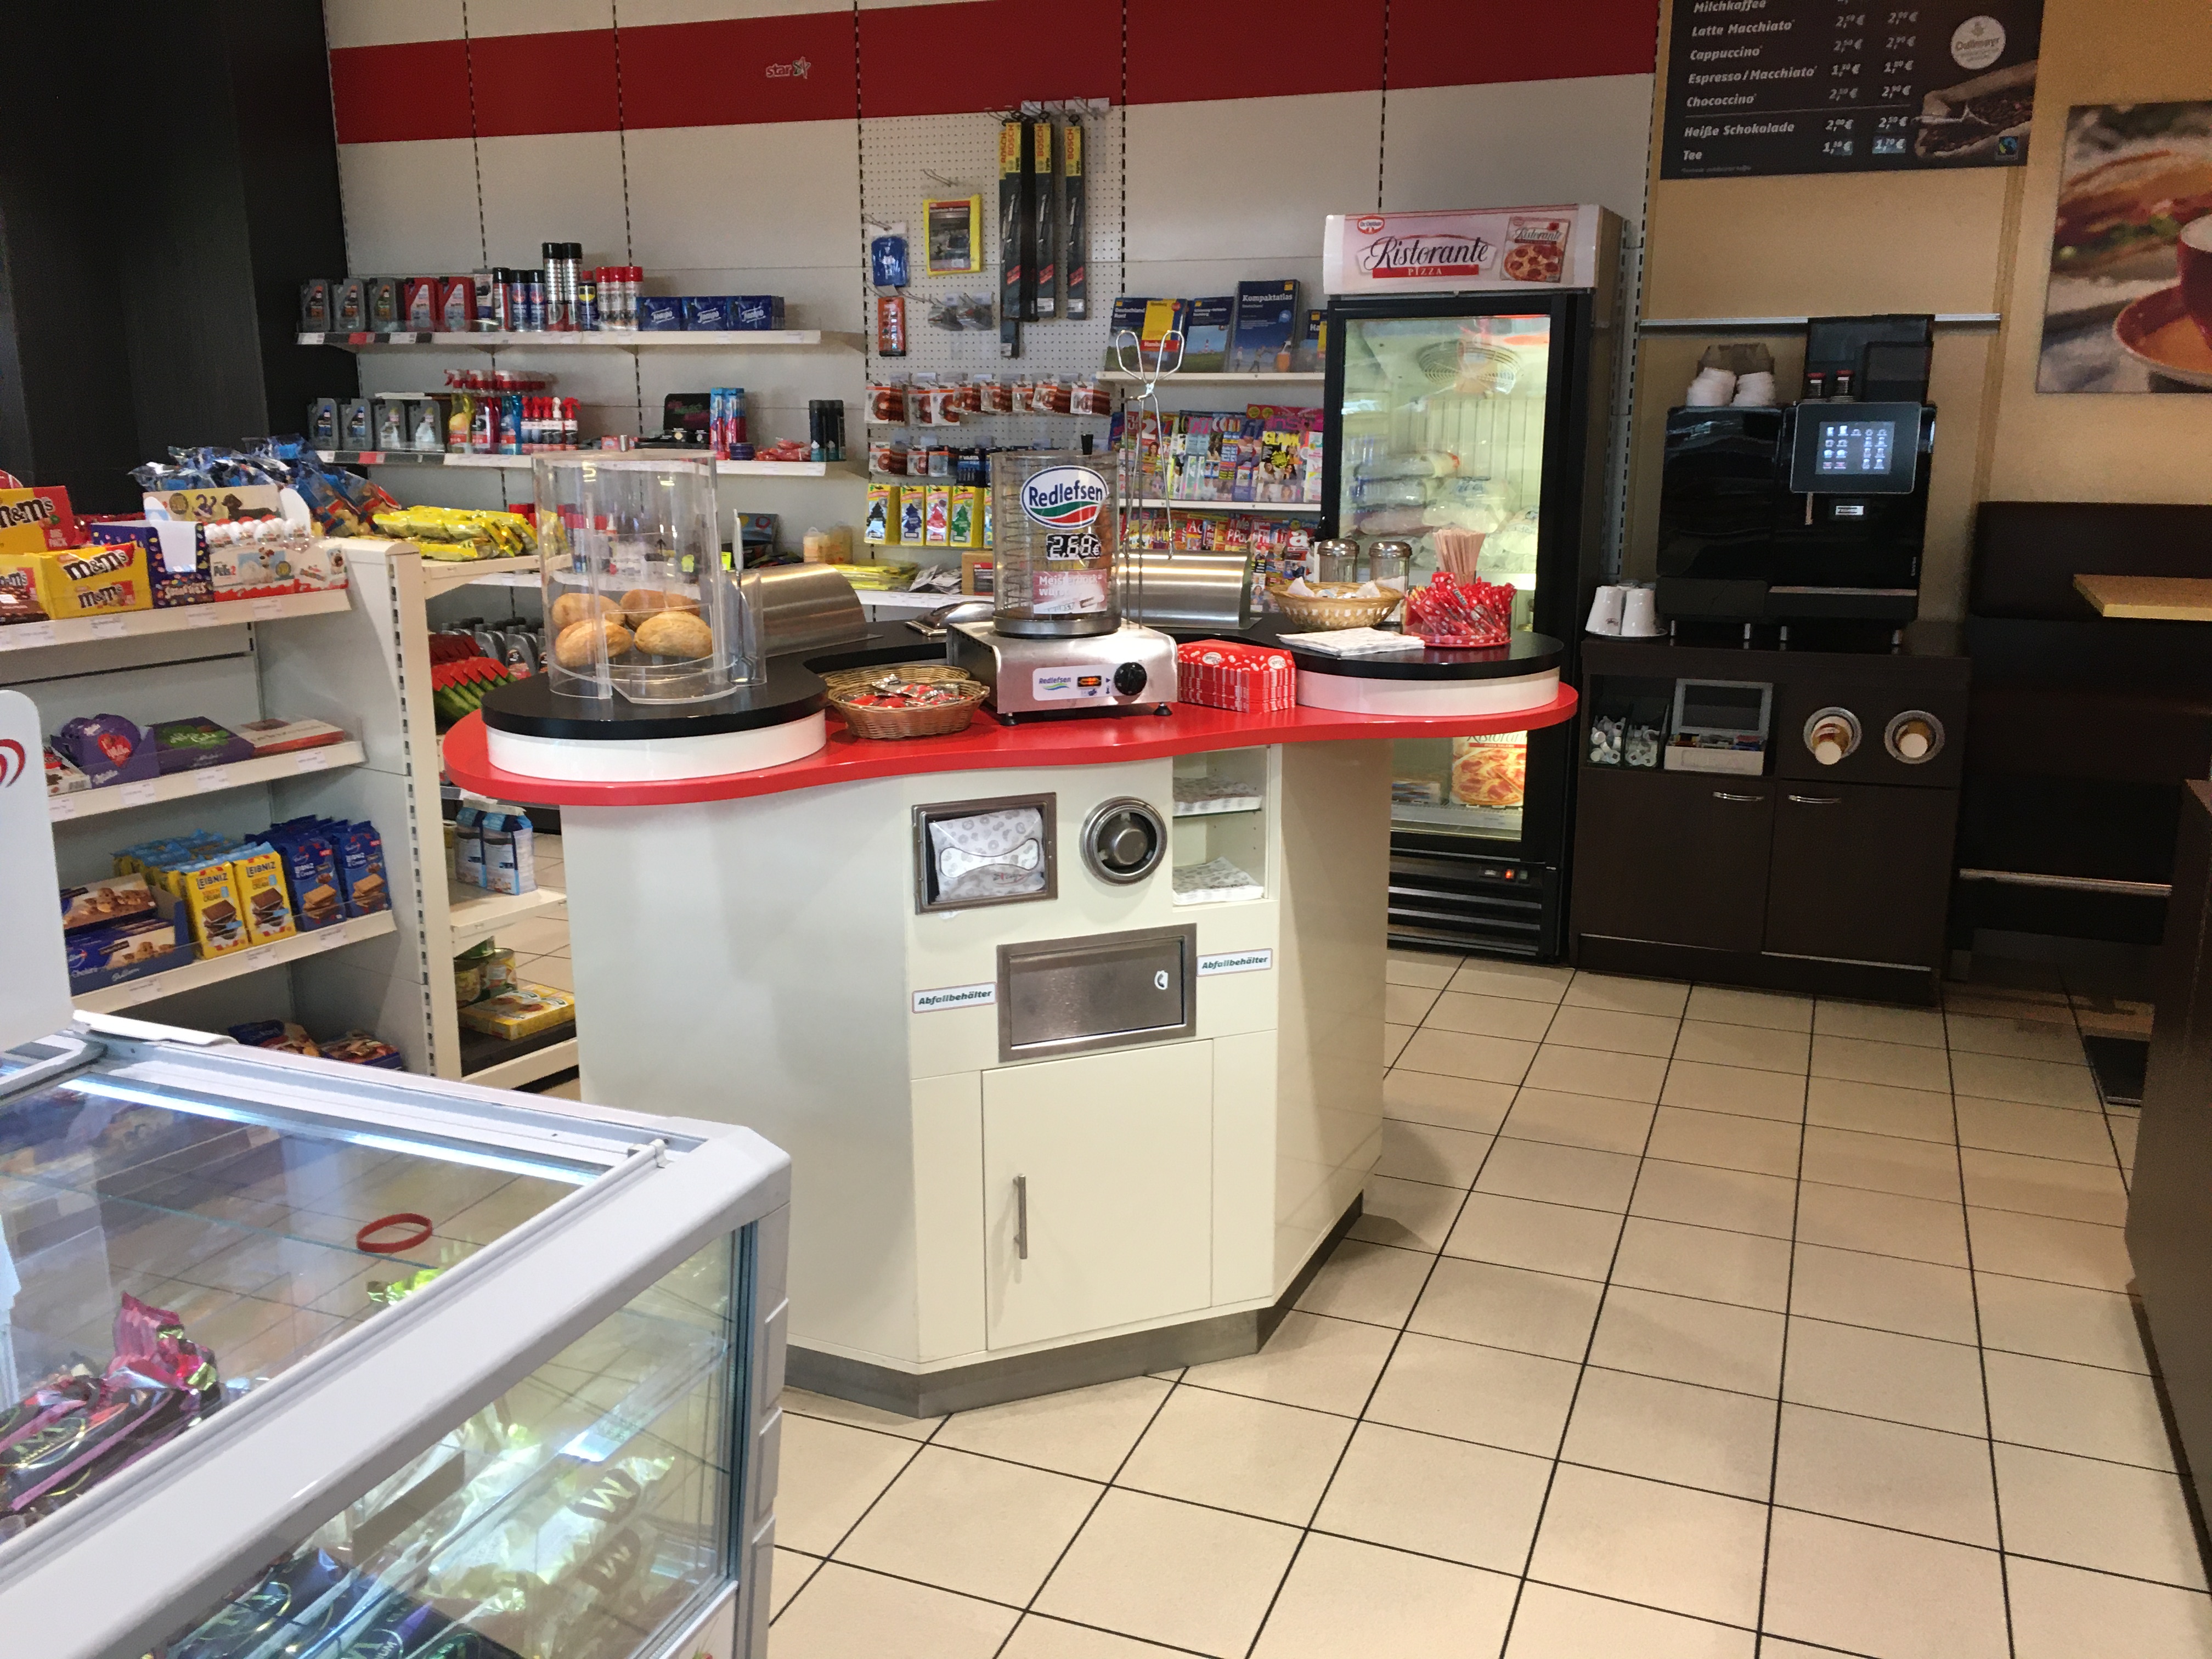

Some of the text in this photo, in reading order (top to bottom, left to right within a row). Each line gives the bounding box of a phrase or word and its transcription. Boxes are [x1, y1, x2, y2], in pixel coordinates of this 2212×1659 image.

[1691, 26, 1724, 37] Latte
[766, 63, 792, 77] star
[1684, 125, 1720, 138] Heiße
[1684, 150, 1702, 161] Tee
[1364, 236, 1489, 271] Ristorante
[1408, 267, 1442, 275] PIZZA
[1242, 293, 1293, 303] Kompaktatlas
[1029, 479, 1103, 507] Redlefsen
[245, 862, 276, 878] LEIBNIZ
[196, 872, 229, 889] LEIBNIZ
[1201, 956, 1268, 970] Abfallbehälter
[918, 990, 992, 1005] Abfallbehälter
